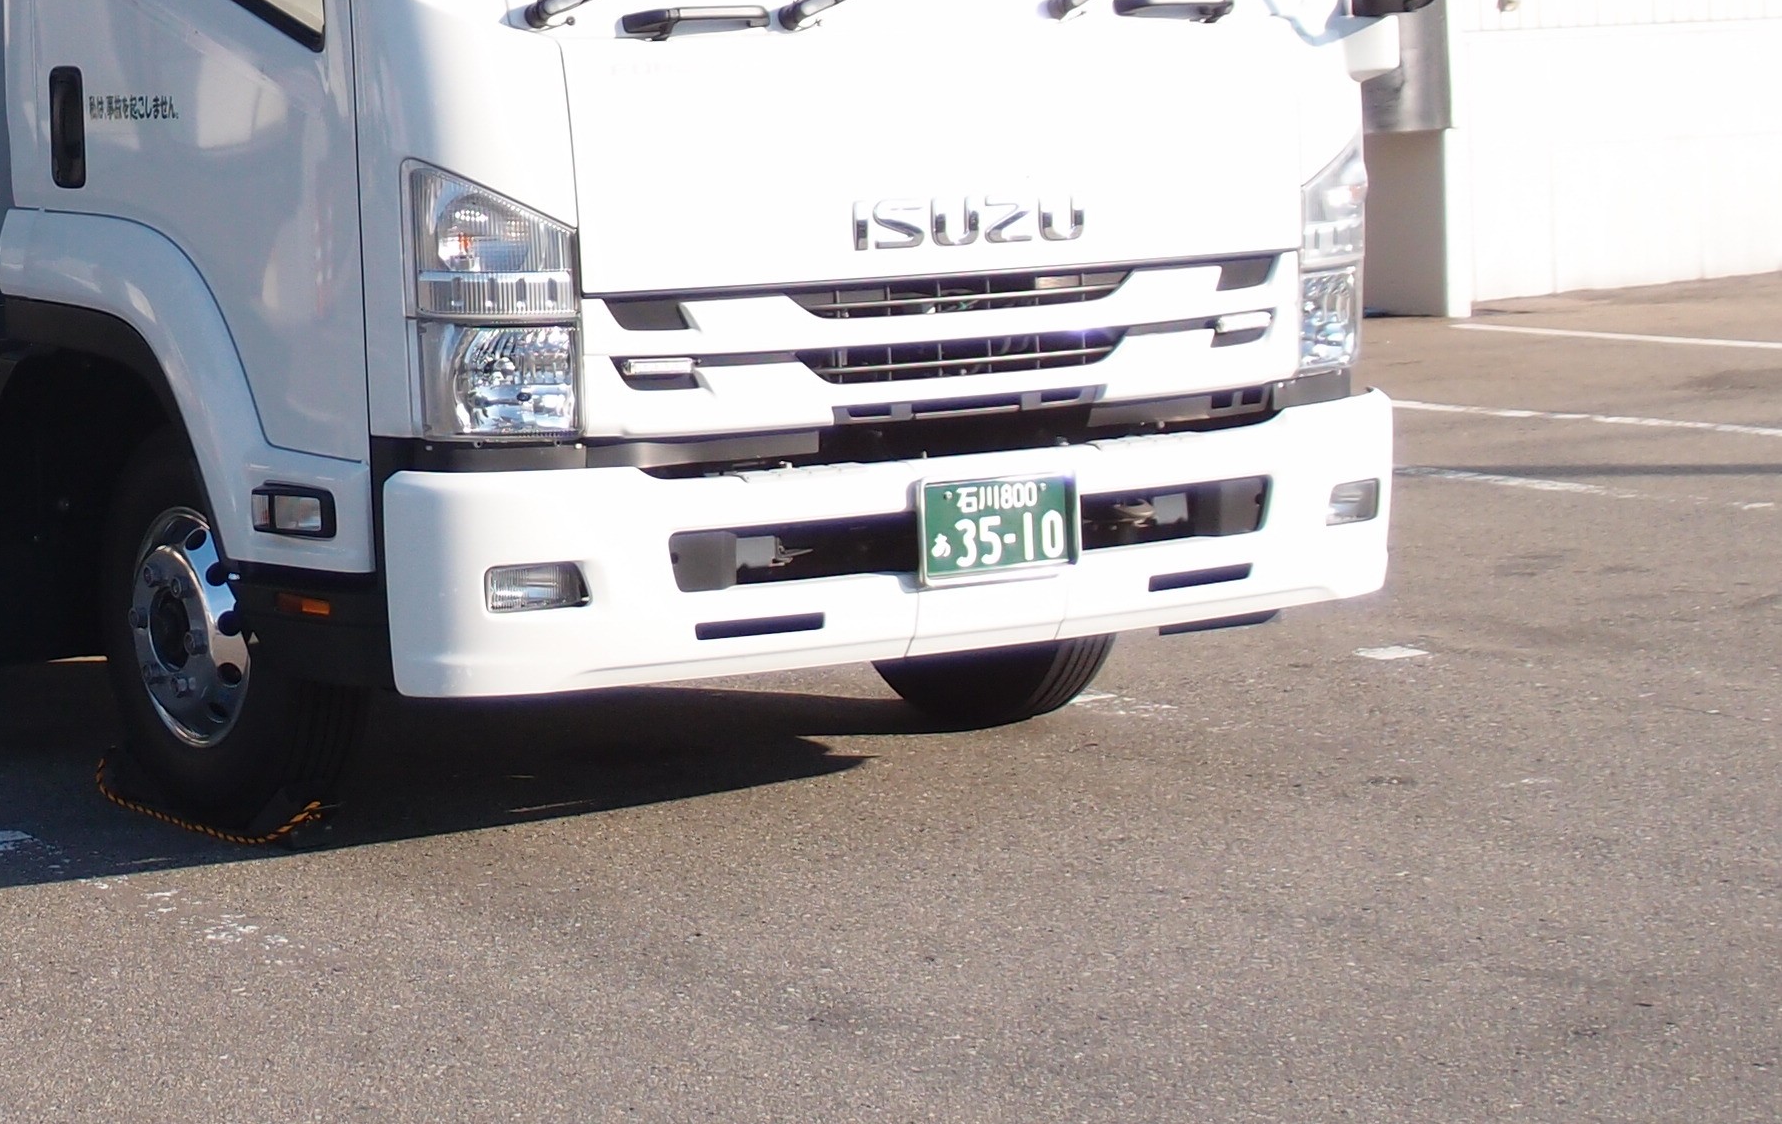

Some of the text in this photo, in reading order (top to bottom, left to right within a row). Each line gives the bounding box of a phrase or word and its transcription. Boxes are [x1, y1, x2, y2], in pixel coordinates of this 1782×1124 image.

[852, 195, 1086, 251] ISUZU
[931, 509, 1064, 568] あ 35-10
